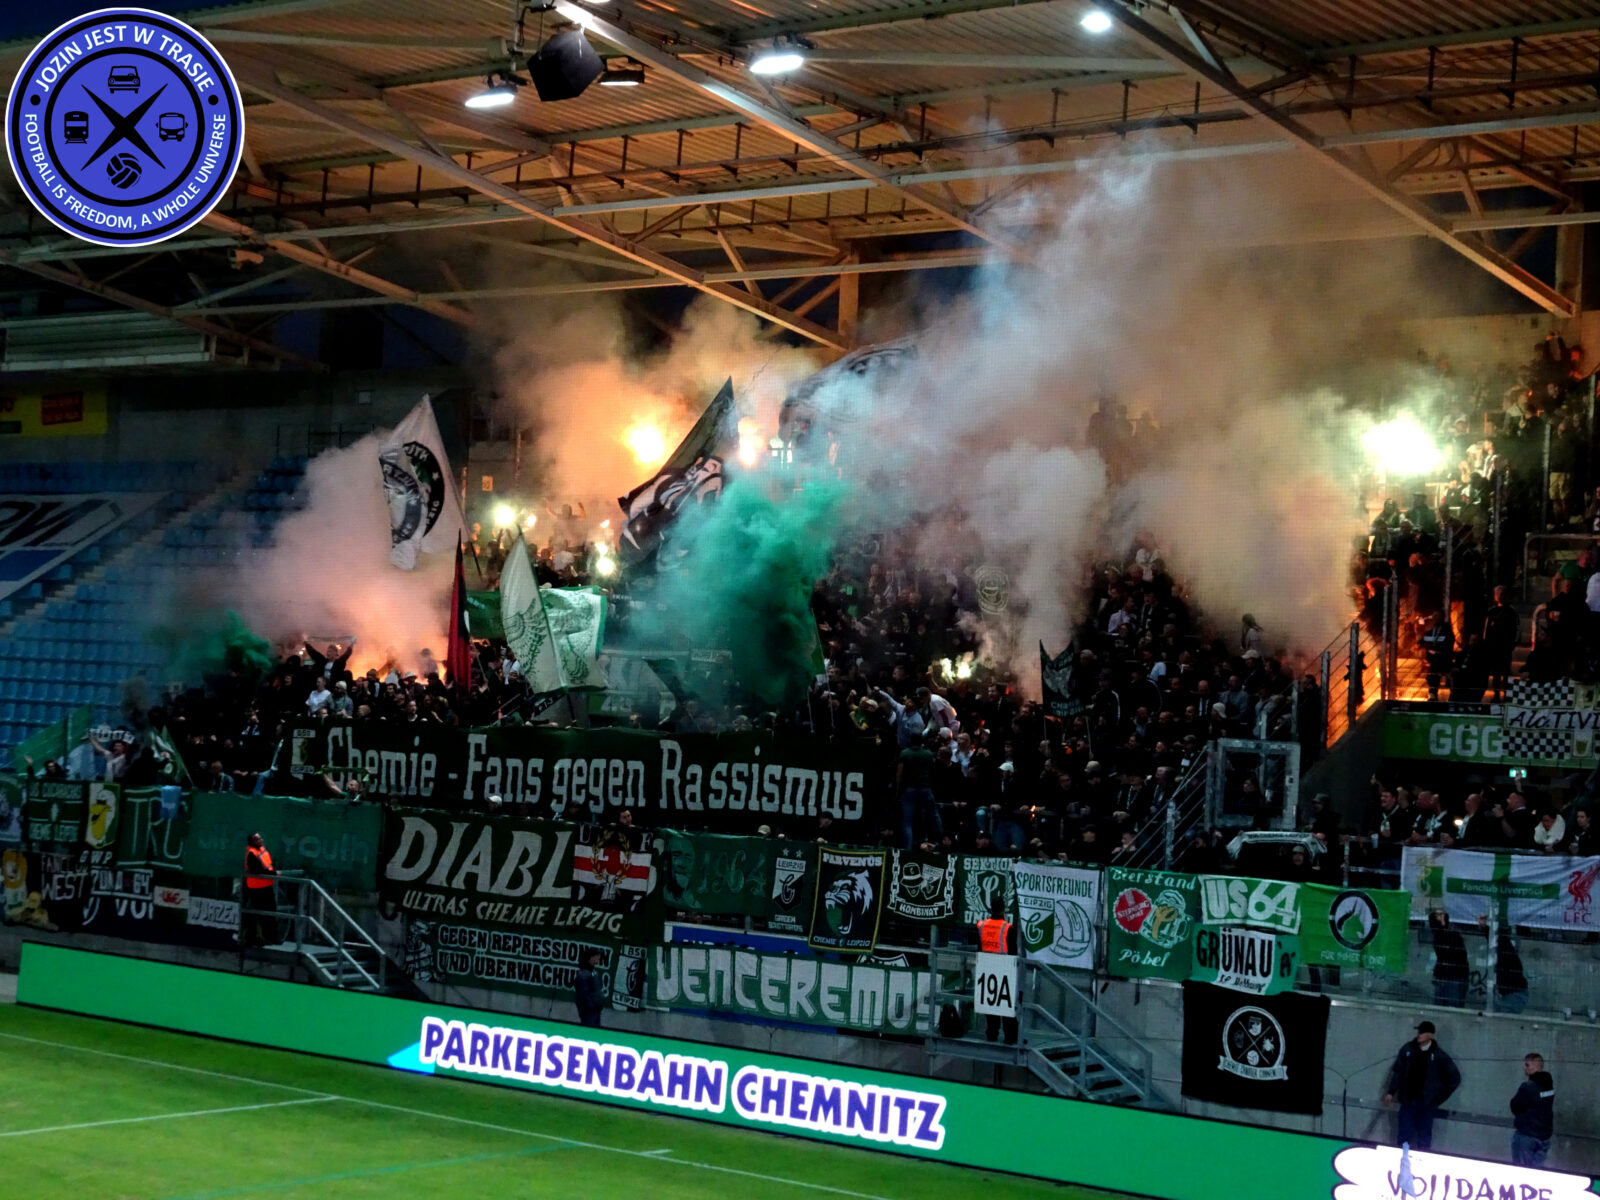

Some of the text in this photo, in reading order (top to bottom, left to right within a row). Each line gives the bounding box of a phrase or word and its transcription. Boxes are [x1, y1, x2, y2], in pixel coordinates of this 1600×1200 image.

[327, 726, 437, 798] Chemie
[463, 733, 544, 803] Fans
[551, 757, 647, 812] gegen
[659, 739, 865, 821] Rassismus
[385, 816, 665, 900] DIABL
[41, 872, 90, 902] WEST
[1016, 871, 1094, 899] SPORTSFREUNDE
[1017, 896, 1053, 909] LEIPZIG
[402, 889, 469, 918] ULTRAS
[475, 900, 546, 928] CHEMIE
[899, 903, 940, 917] KOMBINAT
[1563, 911, 1592, 925] LFC
[437, 951, 471, 975] UND
[438, 925, 612, 969] GEGEN REPRESSIONN
[1196, 927, 1273, 978] GRÜNAU
[976, 971, 1013, 1009] 19A
[421, 1020, 945, 1145] PARKEISENBAHN CHEMNITZ
